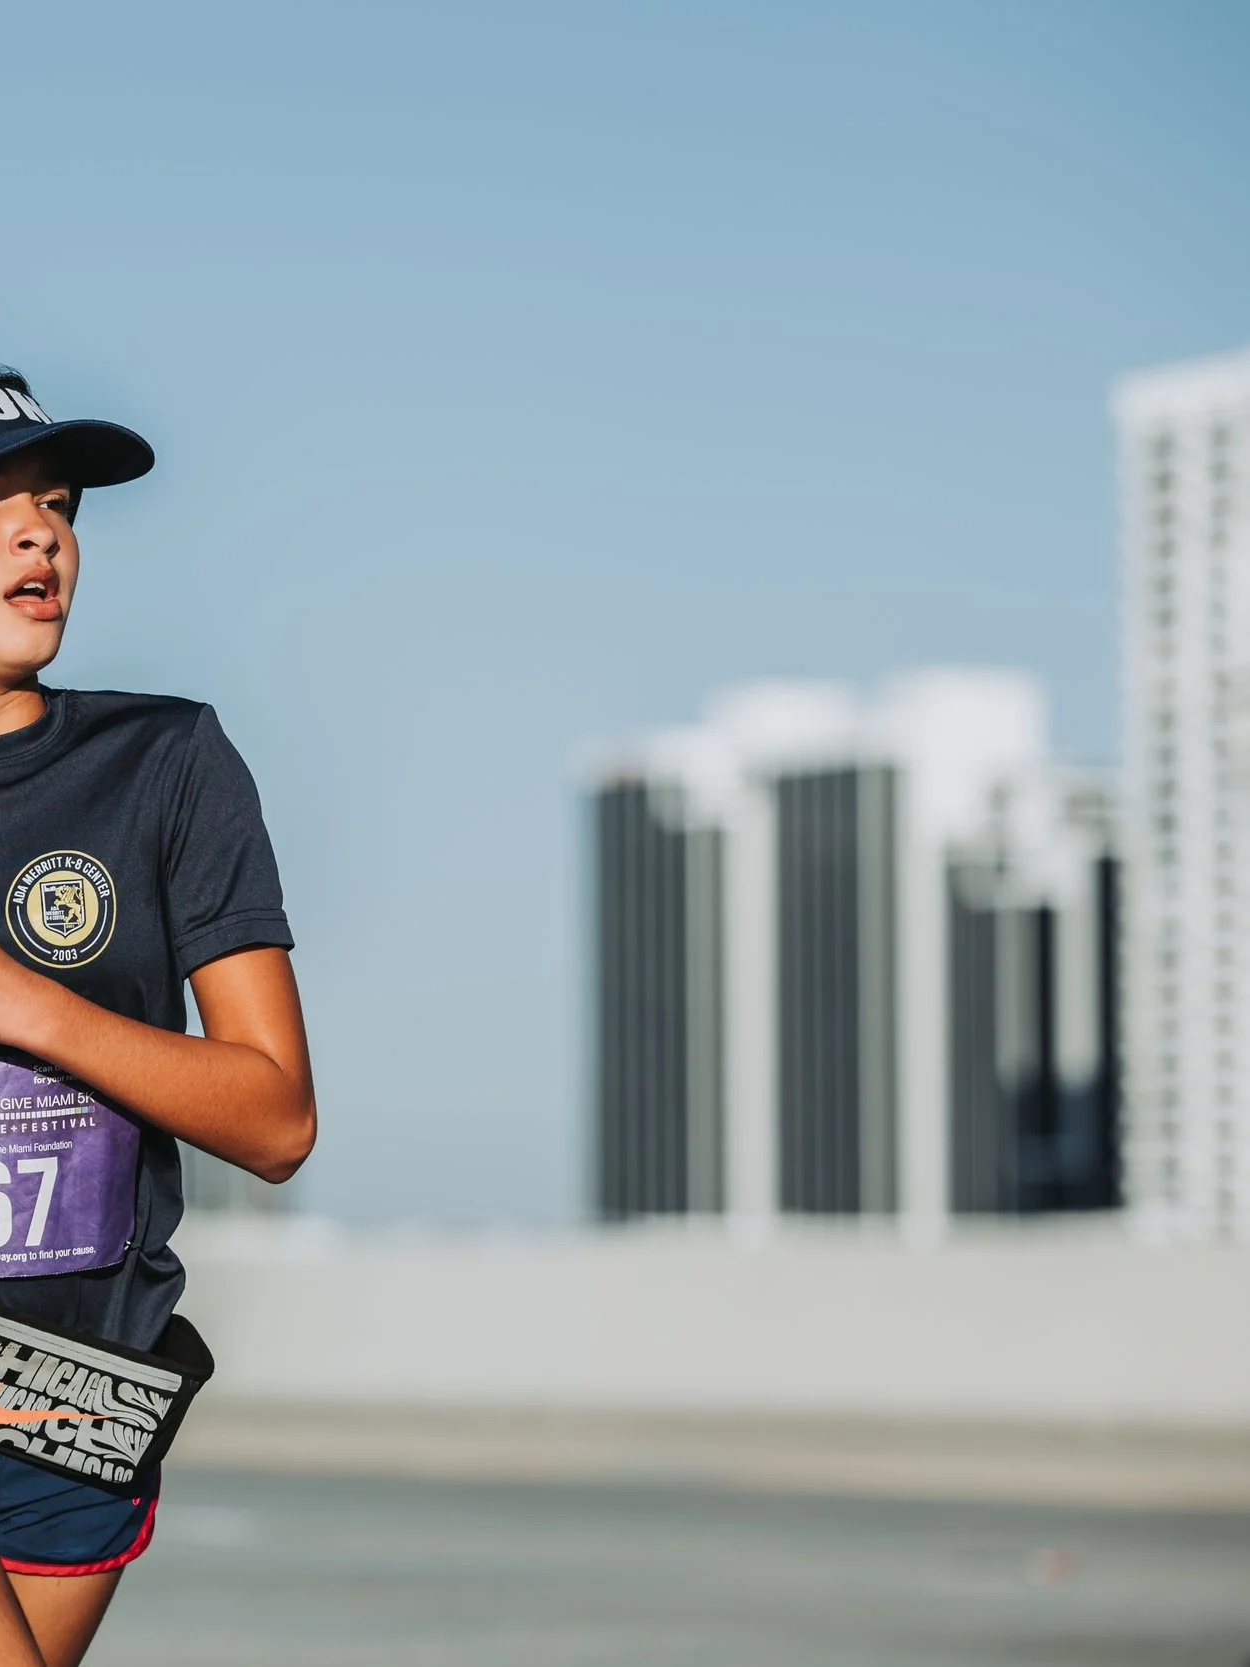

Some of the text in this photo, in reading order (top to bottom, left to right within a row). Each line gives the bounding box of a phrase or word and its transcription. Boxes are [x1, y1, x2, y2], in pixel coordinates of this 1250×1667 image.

[13, 856, 111, 904] ADA MERRITT K-8 CENTER
[52, 948, 78, 961] 2003
[33, 1076, 45, 1084] for
[0, 1097, 33, 1110] GIVE
[36, 1093, 74, 1108] MIAMI
[77, 1091, 96, 1104] 5K
[8, 1143, 32, 1154] Miami
[33, 1140, 73, 1152] Foundation
[29, 1251, 38, 1260] to
[39, 1249, 54, 1259] find
[54, 1248, 71, 1260] your
[72, 1246, 96, 1256] cause.
